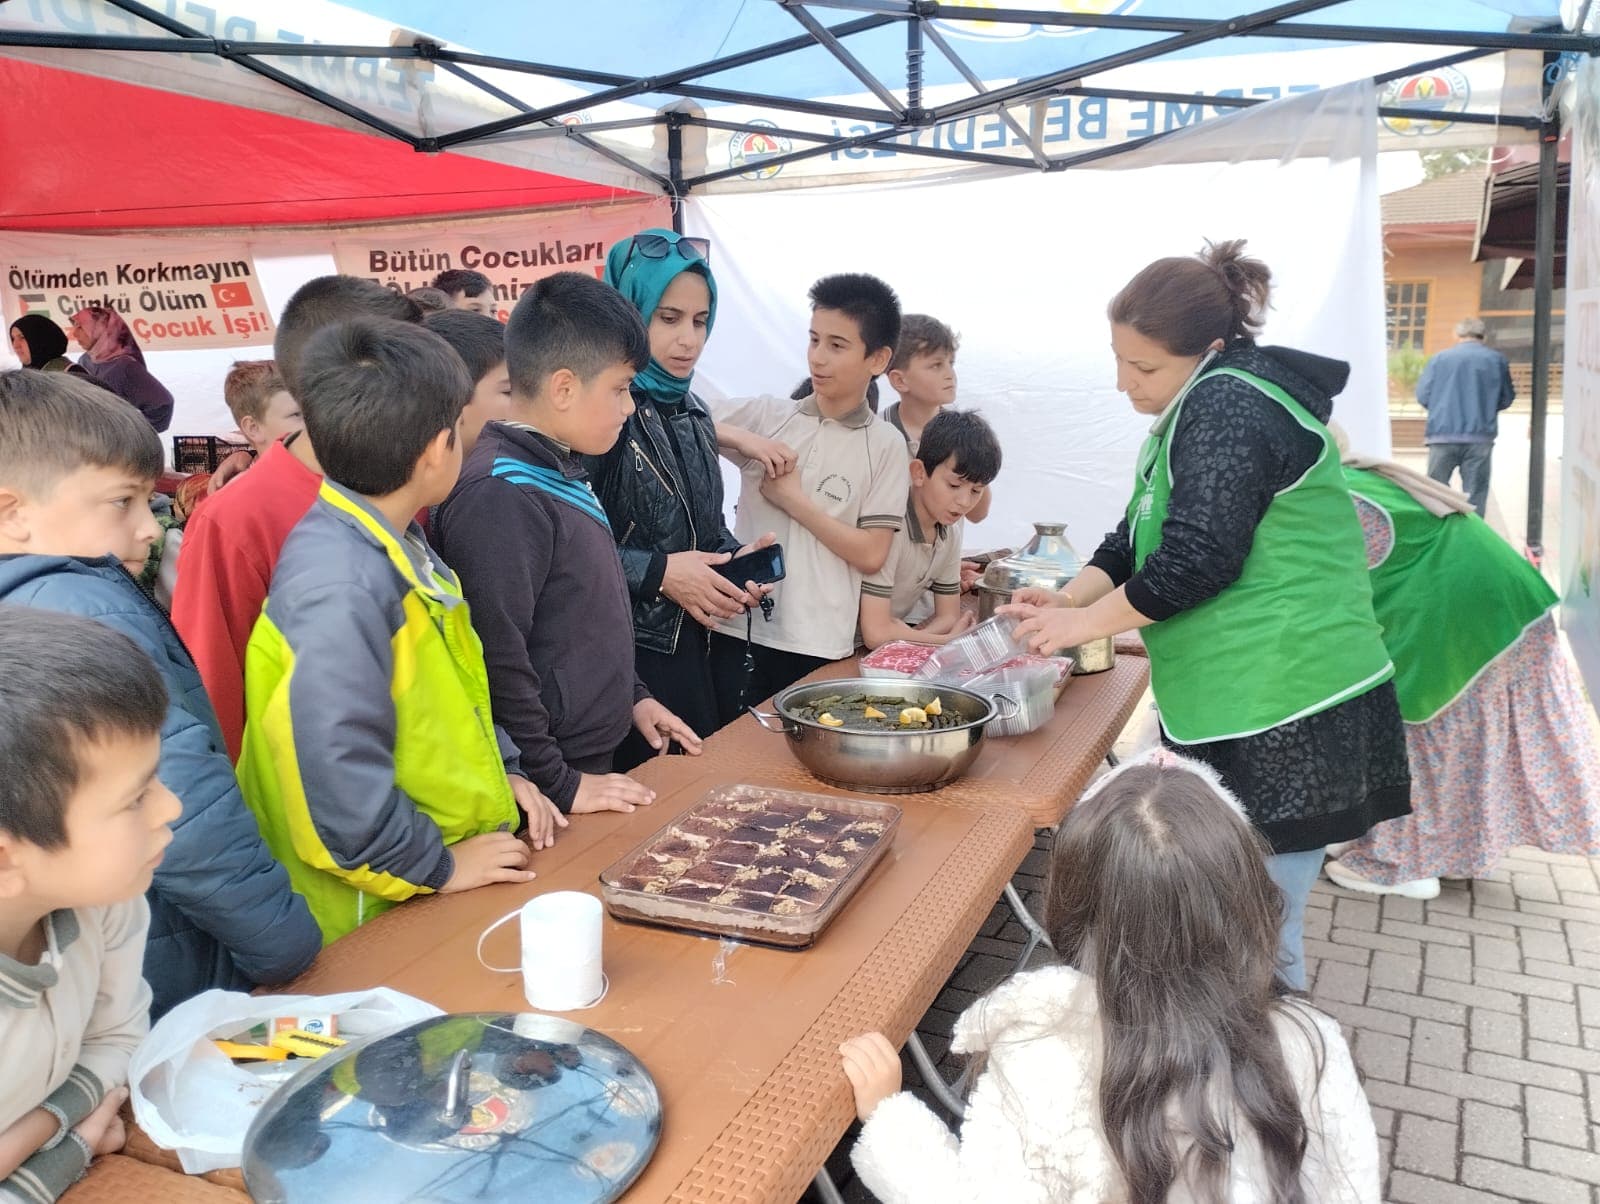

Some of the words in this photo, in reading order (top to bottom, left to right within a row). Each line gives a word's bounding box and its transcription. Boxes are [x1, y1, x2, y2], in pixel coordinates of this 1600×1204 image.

[369, 248, 450, 272] Bütün
[9, 265, 108, 290] Ölümden
[116, 260, 251, 284] Korkmayın
[139, 286, 207, 312] Ölüm
[133, 316, 216, 344] Çocuk
[220, 309, 269, 339] İşi!
